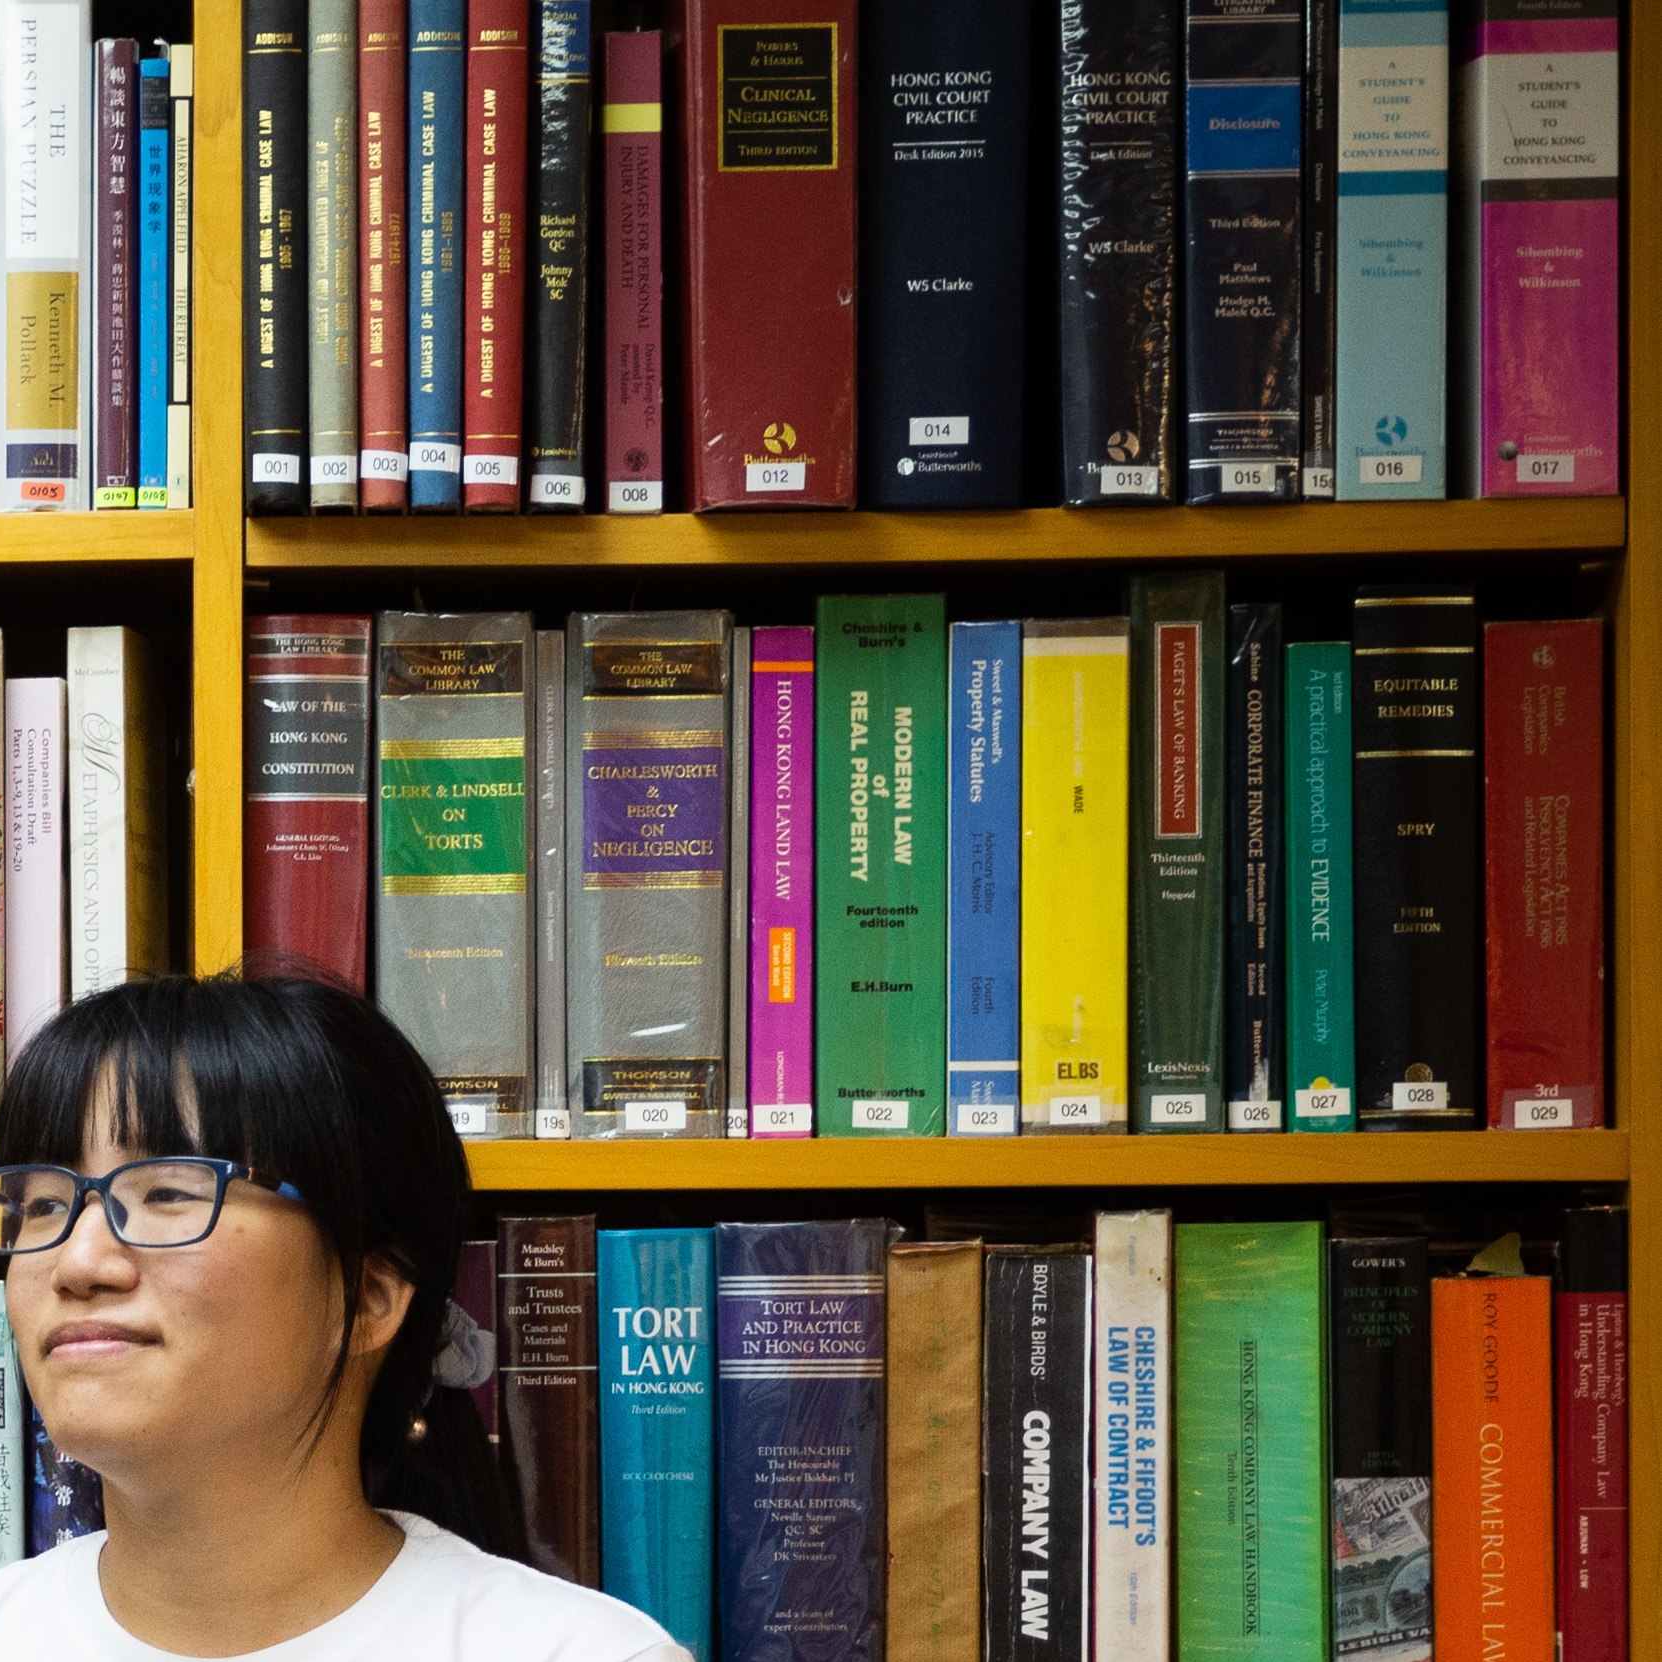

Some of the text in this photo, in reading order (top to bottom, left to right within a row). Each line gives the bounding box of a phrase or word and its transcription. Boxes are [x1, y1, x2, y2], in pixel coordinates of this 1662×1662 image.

[890, 70, 992, 87] HONG KONG
[892, 89, 991, 107] CIVIL COURT
[727, 108, 829, 124] NEGLIGENCE
[905, 109, 977, 125] PRACTICE
[21, 19, 37, 244] PERSIAN PUZZLE
[49, 104, 66, 157] THE
[931, 277, 974, 293] Clarke
[924, 423, 951, 438] 014
[421, 449, 447, 464] 004
[265, 460, 288, 474] 001
[323, 462, 347, 476] 002
[475, 461, 501, 477] 005
[1531, 460, 1560, 476] 017
[761, 468, 789, 484] 012
[1234, 469, 1262, 485] 015
[621, 487, 649, 503] 008
[1373, 677, 1459, 694] EQUITABLE
[1377, 704, 1455, 719] REMEDIES
[586, 763, 718, 781] CHARLESWORTH
[381, 782, 525, 799] CLERK & LINDSELL
[646, 785, 660, 799] &
[776, 680, 792, 900] HONG KONG LAND LAW
[850, 690, 868, 882] REAL PROPERTY
[872, 774, 890, 798] of
[894, 707, 913, 865] MODERN LAW
[441, 807, 466, 823] ON
[626, 803, 679, 819] PERCY
[640, 822, 666, 838] ON
[1397, 822, 1436, 836] SPRY
[424, 833, 484, 851] TORTS
[592, 839, 714, 859] NEGLIGENCE
[1165, 1100, 1194, 1115] 025
[1310, 1094, 1338, 1110] 027
[641, 1108, 669, 1123] 020
[769, 1110, 795, 1125] 021
[865, 1106, 893, 1122] 022
[971, 1110, 999, 1126] 023
[1530, 1105, 1559, 1121] 029
[543, 1116, 566, 1130] 19s
[761, 1299, 845, 1316] TORT LAW
[612, 1306, 703, 1339] TORT
[741, 1319, 864, 1336] AND PRACTICE
[742, 1338, 866, 1355] IN HONG KONG
[621, 1344, 696, 1376] LAW
[1107, 1326, 1130, 1530] LAW OF CONTRACT
[1134, 1325, 1157, 1547] CHESHIRE & FIFOOT'S
[1021, 1409, 1051, 1641] COMPANY LAW
[1479, 1422, 1506, 1613] COMMERCIAL
